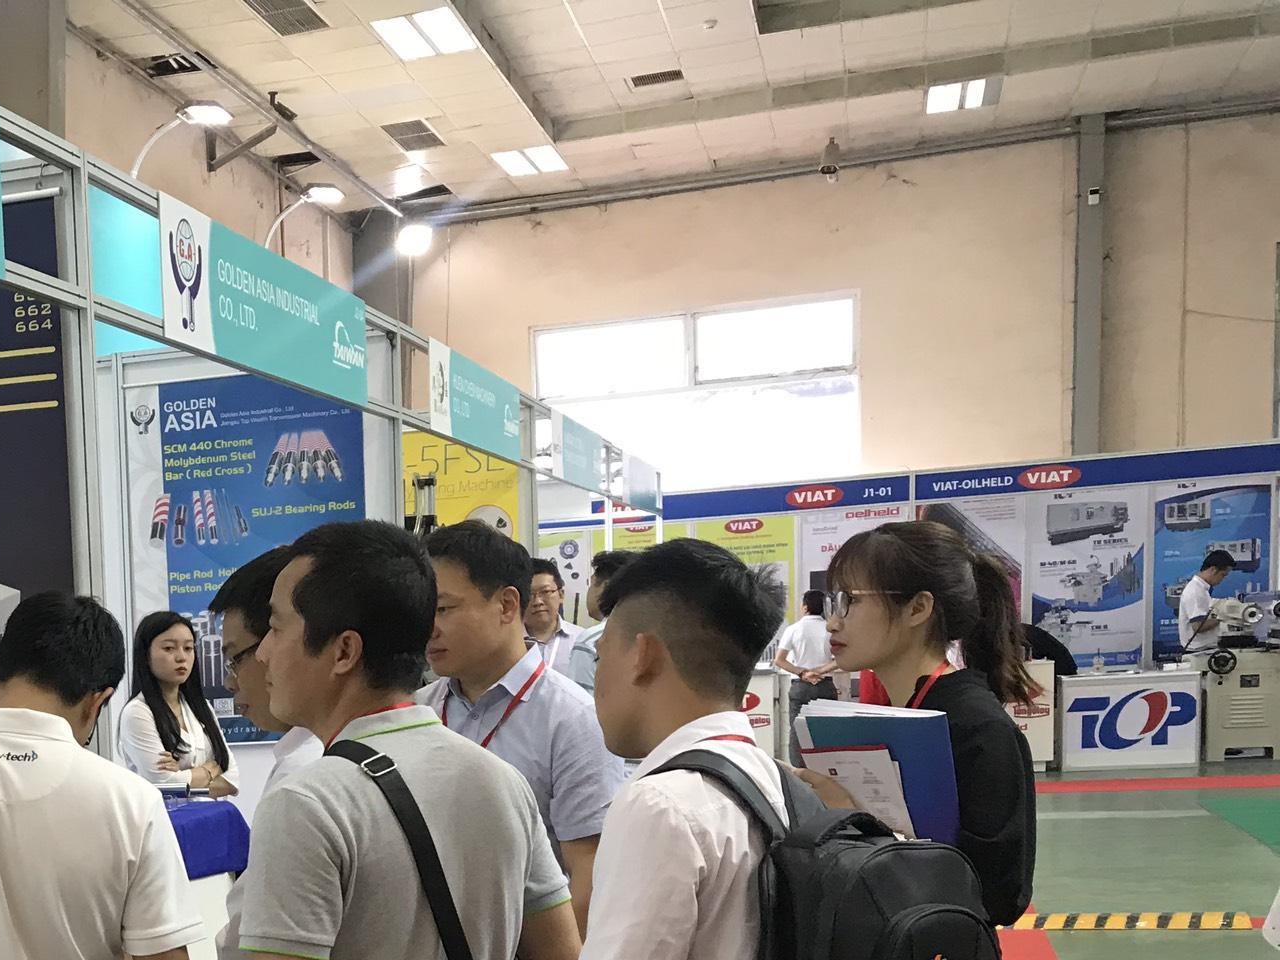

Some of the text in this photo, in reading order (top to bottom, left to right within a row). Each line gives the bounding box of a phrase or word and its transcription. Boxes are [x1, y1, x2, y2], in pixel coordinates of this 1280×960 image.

[217, 258, 255, 296] GOLDEN
[255, 274, 274, 304] ASIA
[275, 286, 320, 327] INDUSTRIAL
[14, 303, 52, 318] 662
[218, 295, 258, 331] CO., LTD.
[15, 318, 53, 333] 664
[333, 340, 365, 368] TAIWAN
[163, 397, 216, 413] GOLDEN
[164, 411, 218, 433] ASIA
[163, 438, 254, 455] SCM 440 Chrome
[164, 450, 256, 468] Molybdenum Steel
[165, 465, 245, 481] Bar Red Cross
[932, 469, 1072, 491] VIAT-OILHELD VIAT
[794, 486, 892, 503] VIAT J1-01
[251, 500, 356, 518] SUJ-2 Bearing Rods
[729, 520, 758, 531] VIAT
[193, 569, 213, 579] Rod
[170, 584, 202, 594] Piston
[1066, 688, 1197, 750] TOP
